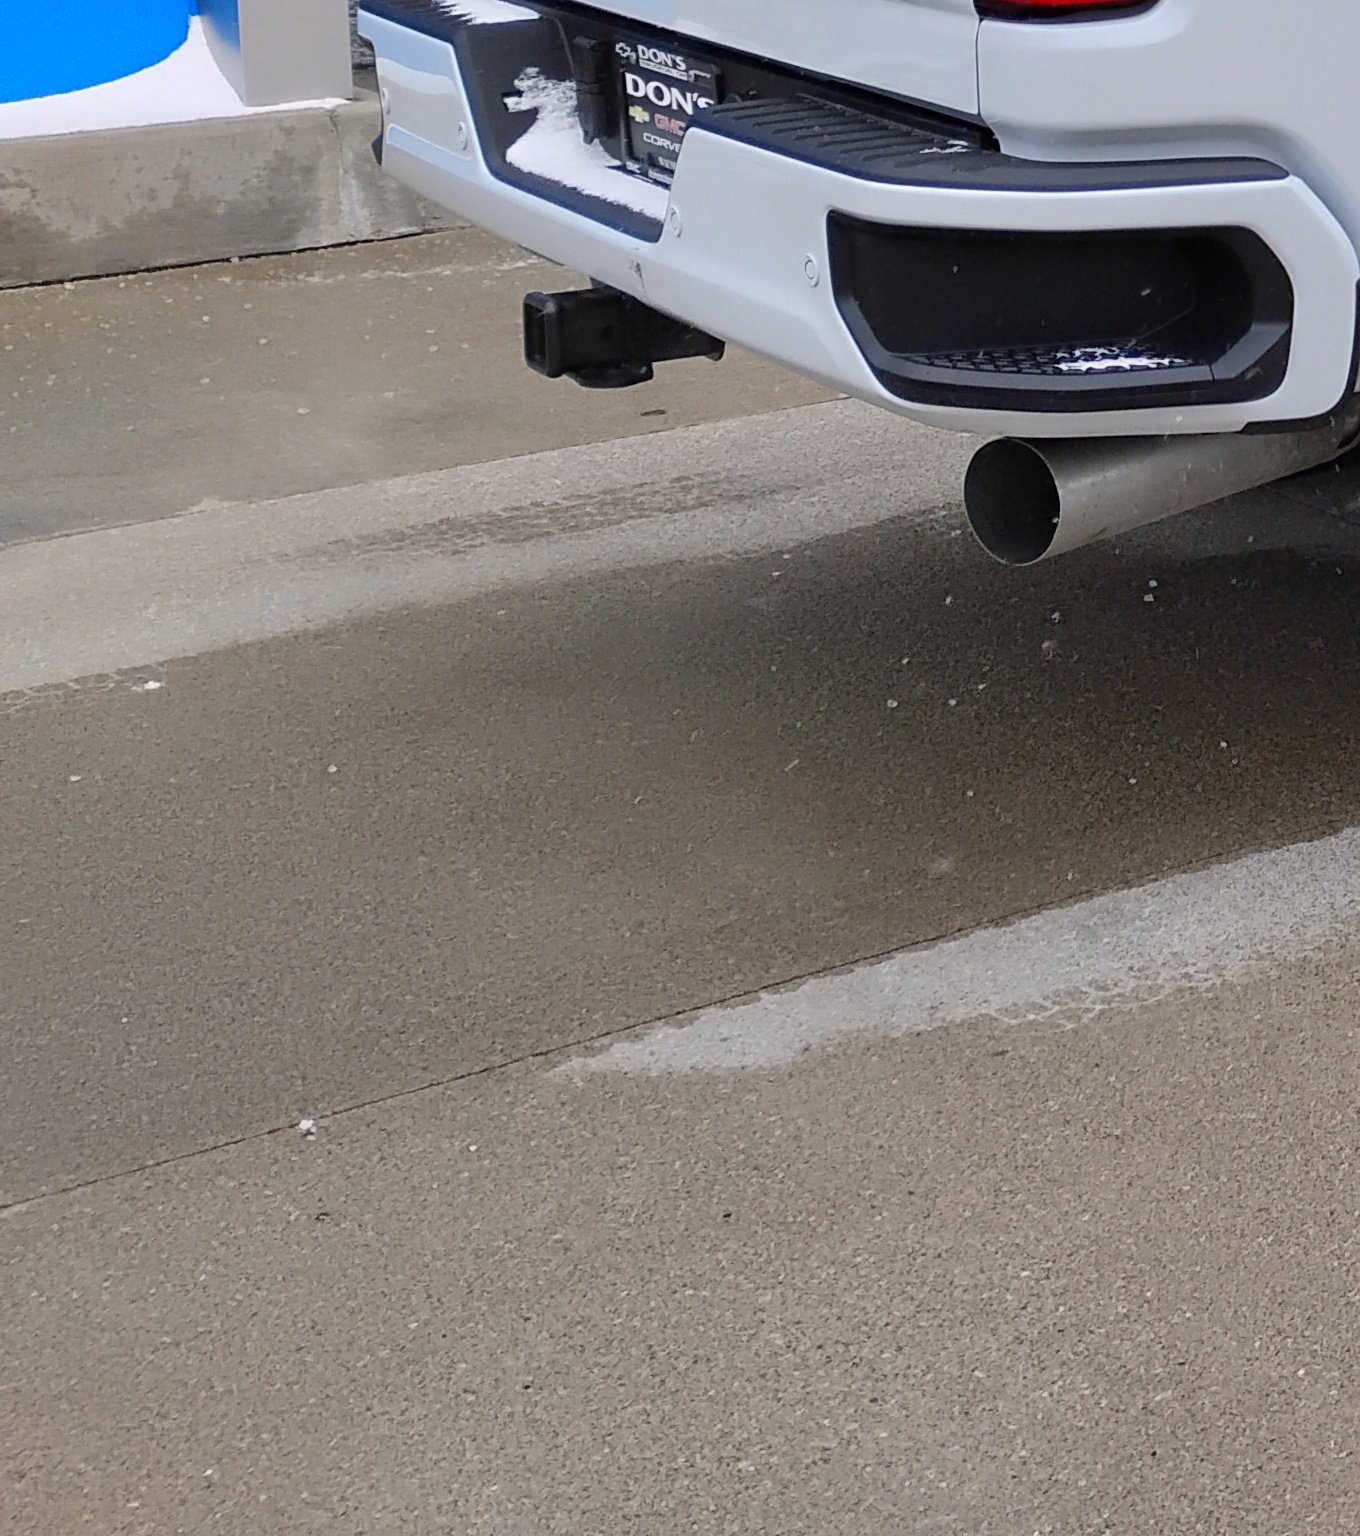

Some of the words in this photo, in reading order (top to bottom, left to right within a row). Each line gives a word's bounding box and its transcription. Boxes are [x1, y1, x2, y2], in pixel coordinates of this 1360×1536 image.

[636, 43, 687, 72] DON'S
[654, 113, 687, 137] GMC
[643, 132, 682, 153] CORVE
